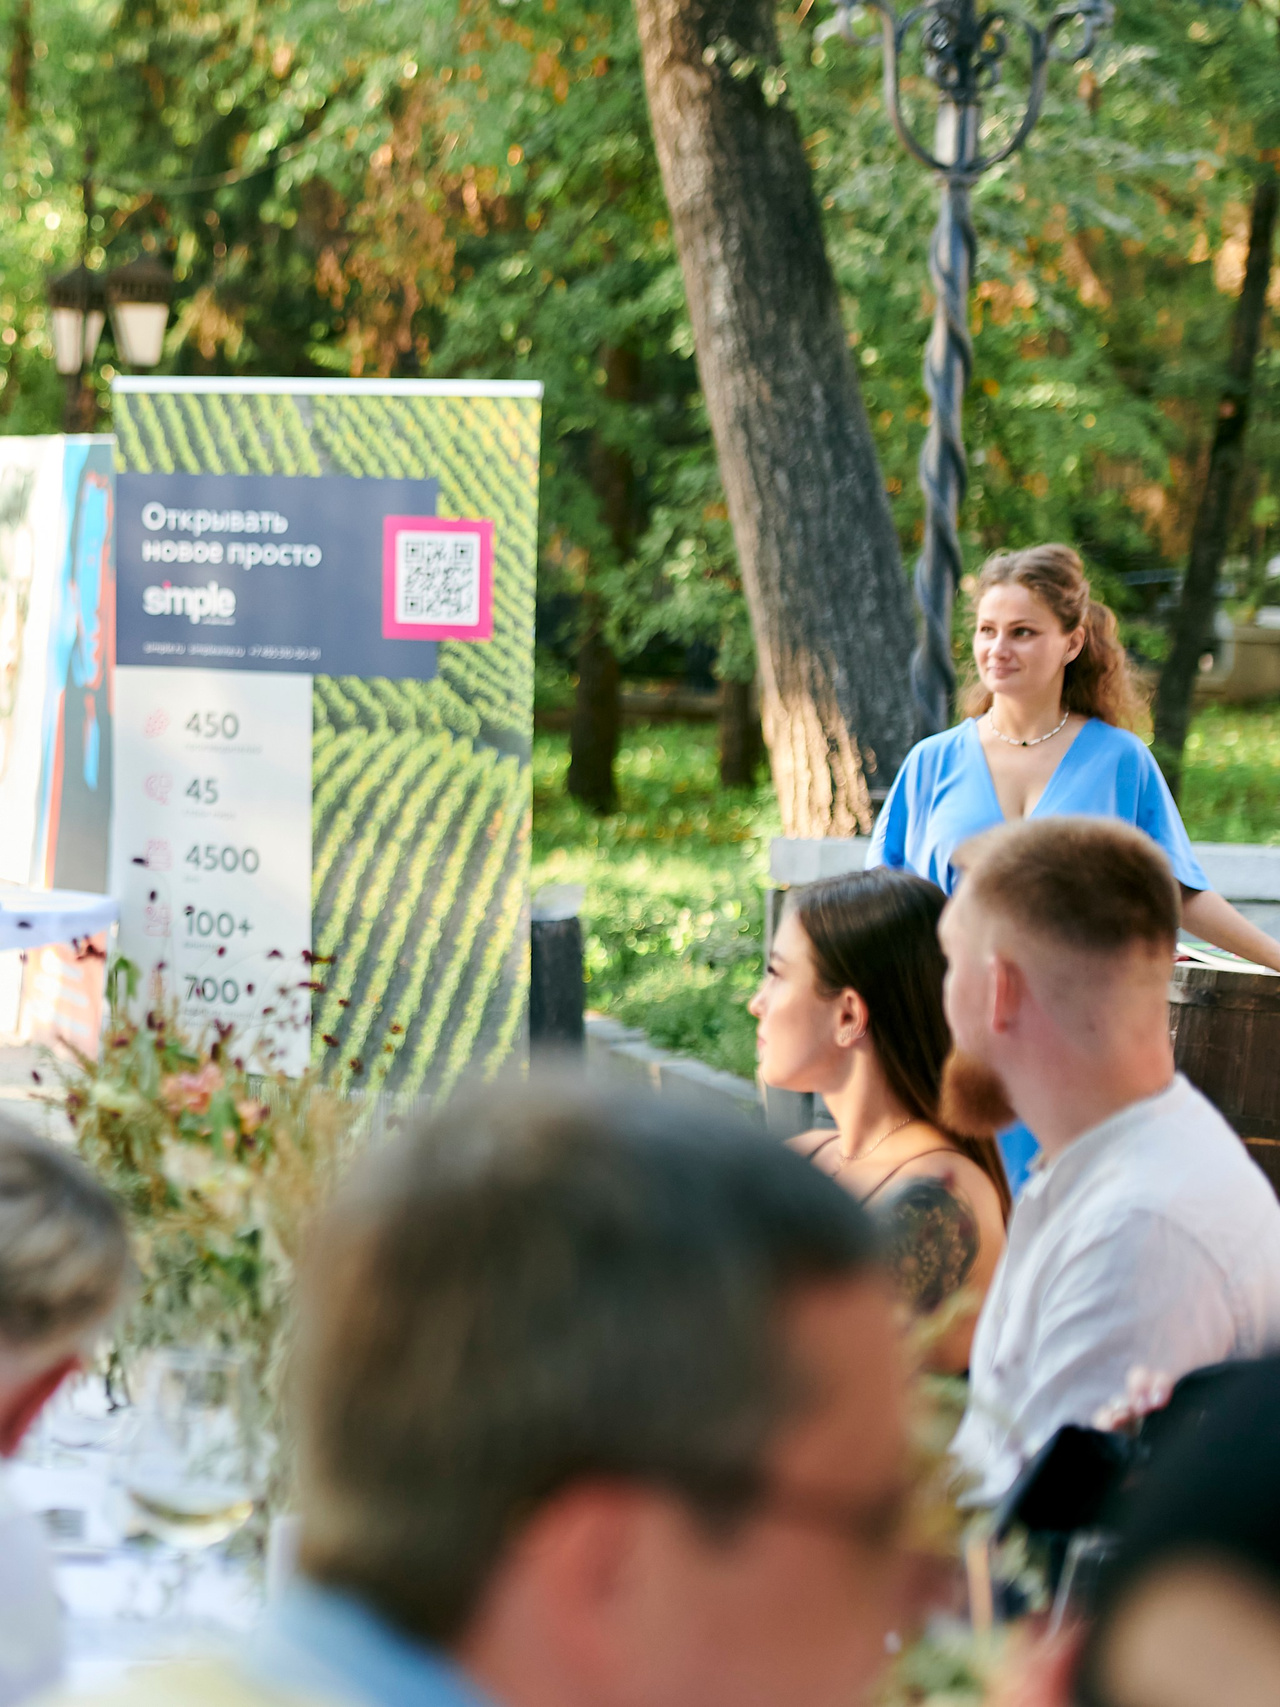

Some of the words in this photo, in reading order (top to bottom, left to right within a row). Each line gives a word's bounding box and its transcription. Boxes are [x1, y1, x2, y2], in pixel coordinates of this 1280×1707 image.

[141, 501, 289, 537] Открывать
[141, 540, 224, 564] новое
[227, 543, 322, 571] просто
[142, 580, 237, 624] simple
[185, 711, 240, 740] 450
[185, 777, 219, 804] 45
[185, 844, 260, 873] 4500
[185, 910, 252, 938] 100+
[184, 975, 239, 1004] 700
